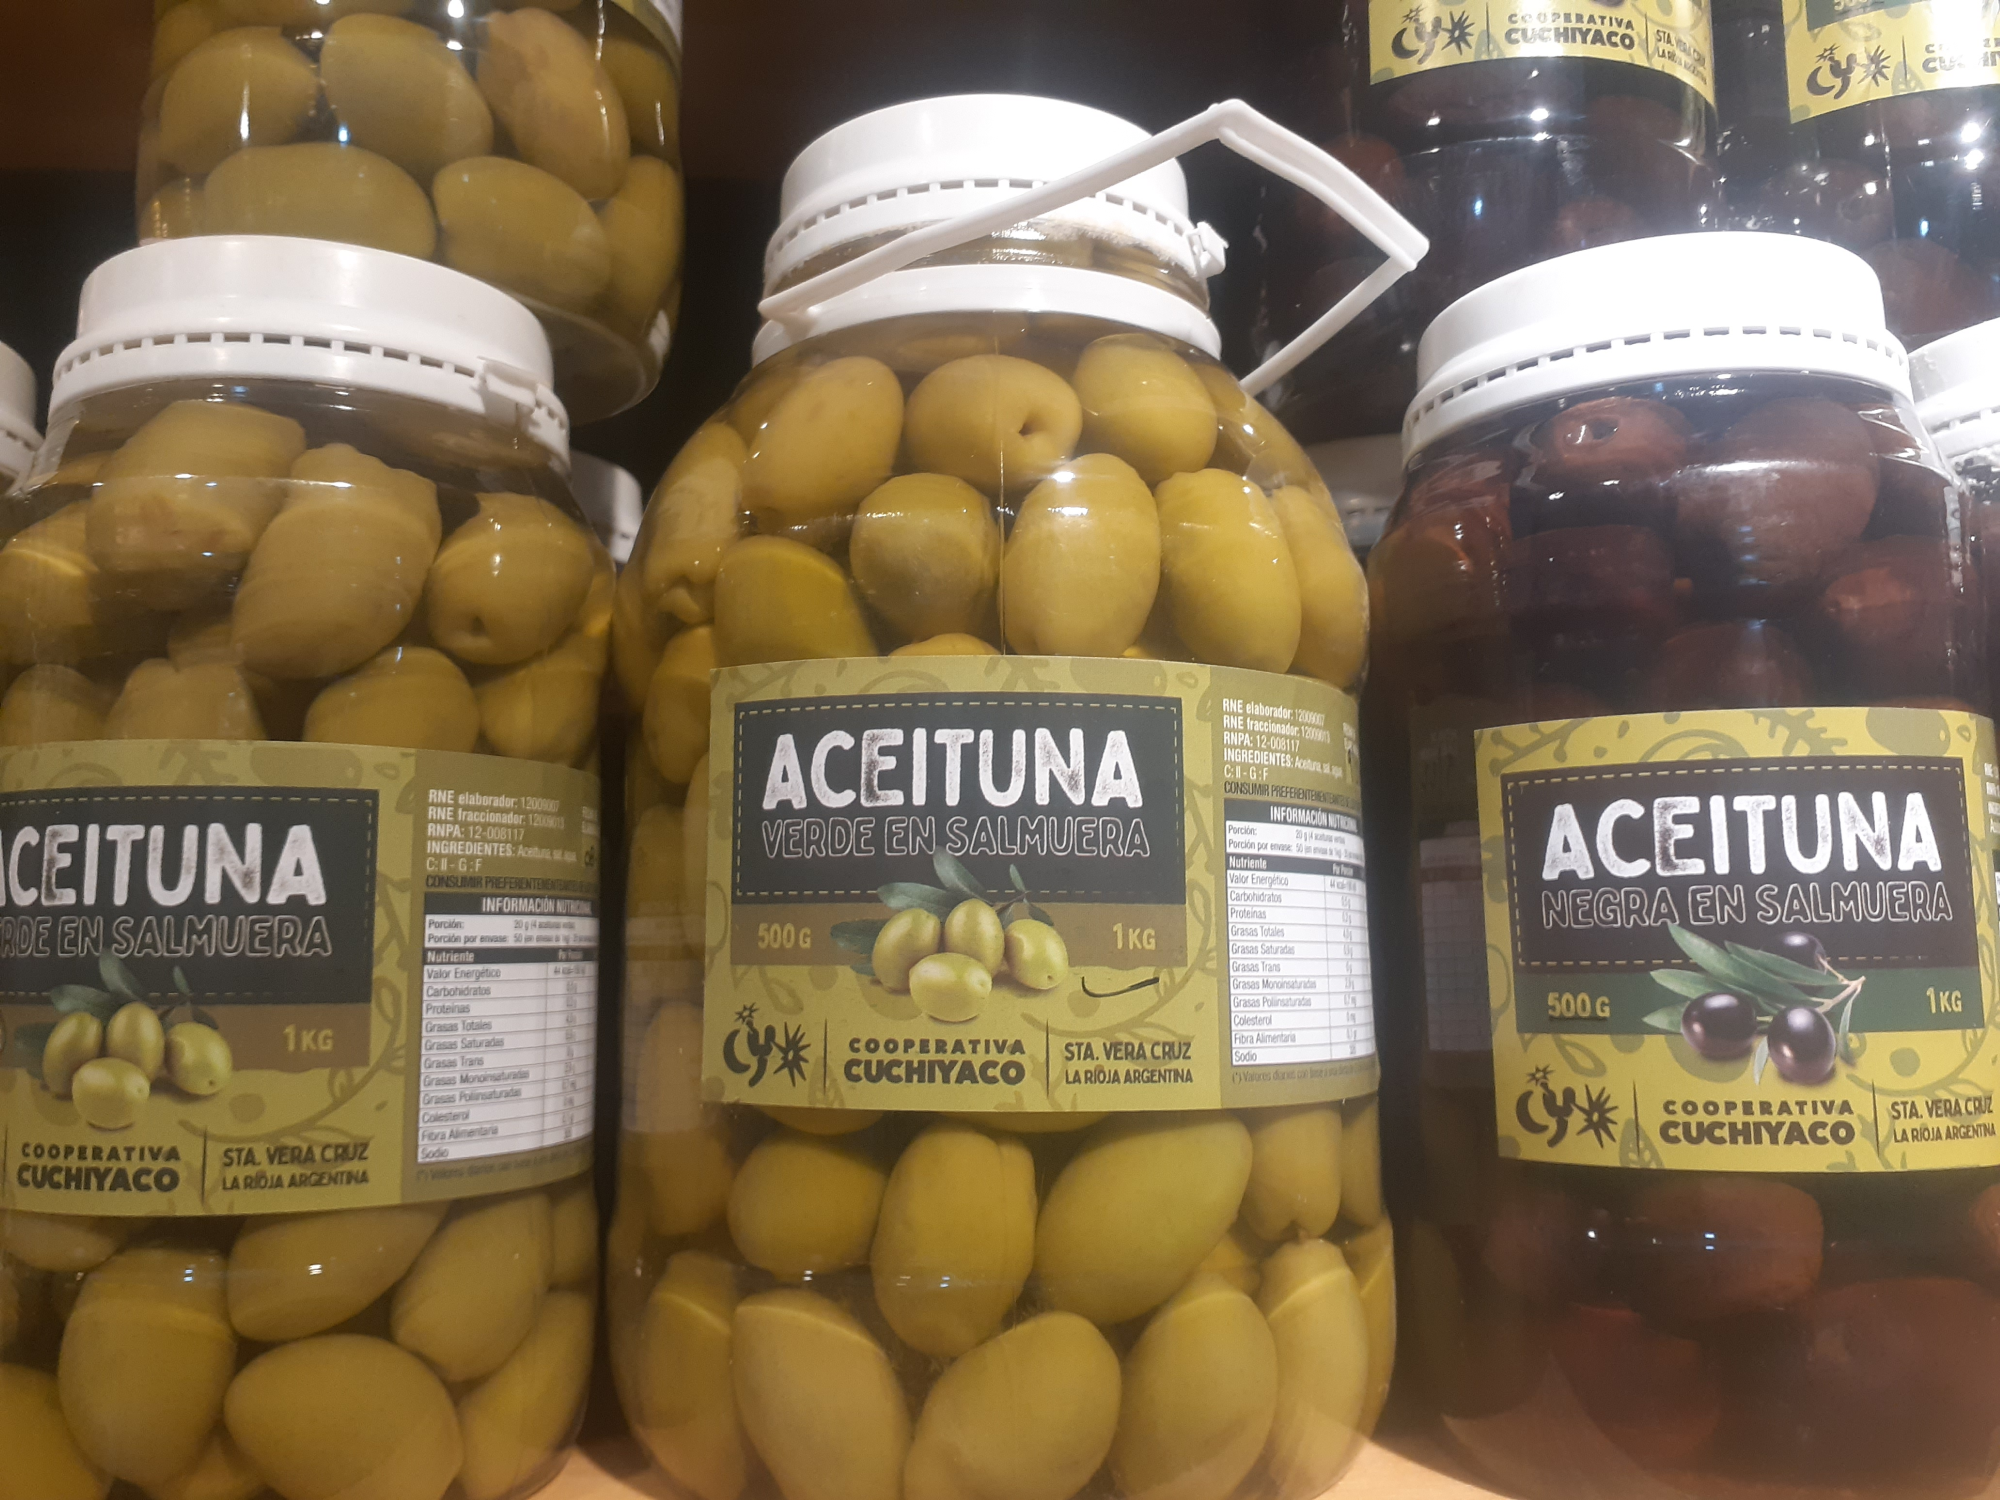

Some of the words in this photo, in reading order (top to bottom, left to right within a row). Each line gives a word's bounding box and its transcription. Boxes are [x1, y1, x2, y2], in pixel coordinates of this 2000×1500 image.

[1507, 12, 1635, 31] COOPERATIVA
[1504, 26, 1636, 51] CUCHIYACO
[1223, 698, 1243, 713] RNE
[1246, 701, 1293, 720] elaborador:
[1223, 715, 1244, 729] RNE
[1247, 717, 1300, 737] fraccionador:
[1223, 731, 1253, 747] RNPA:
[1223, 748, 1293, 767] INGREDIENTES:
[762, 728, 1143, 810] ACEITUNA
[1224, 781, 1270, 797] CONSUMIR
[428, 789, 455, 804] RNE
[458, 792, 518, 809] elaborador:
[427, 807, 454, 821] RNE
[458, 808, 526, 825] fraccionador:
[1270, 805, 1328, 827] INFORMACIÓN
[427, 823, 465, 838] RNPA:
[468, 826, 525, 841] 12-008117
[762, 817, 875, 858] VERDE
[885, 816, 936, 855] EN
[946, 815, 1150, 857] SALMUERA
[1228, 825, 1257, 836] Porción:
[1541, 791, 1943, 881] ACEITUNA
[427, 841, 515, 856] INGREDIENTES:
[1228, 839, 1256, 850] Porción
[1257, 841, 1269, 852] por
[0, 822, 327, 907] CEITUNA
[1229, 858, 1267, 870] Nutriente
[426, 875, 483, 889] CONSUMIR
[1229, 873, 1249, 887] Valor
[1251, 874, 1289, 889] Energético
[482, 896, 555, 913] INFORMACIÓN
[1229, 890, 1282, 904] Carbohidratos
[1541, 886, 1678, 929] NEGRA
[1688, 884, 1746, 925] EN
[1756, 880, 1953, 923] SALMUERA
[1230, 907, 1267, 919] Proteínas
[428, 919, 464, 930] Porción:
[1230, 925, 1259, 937] Grasas
[1260, 925, 1285, 938] Totales
[58, 915, 104, 957] EN
[112, 914, 332, 957] SALMUERA
[428, 934, 461, 943] Porción
[464, 935, 477, 945] por
[427, 951, 474, 962] Nutriente
[1231, 943, 1259, 955] Grasas
[1260, 943, 1295, 955] Saturadas
[427, 968, 451, 979] Valor
[454, 968, 501, 981] Energético
[1232, 961, 1259, 973] Grasas
[1261, 961, 1281, 973] Trans
[426, 985, 491, 997] Carbohidratos
[1232, 979, 1260, 990] Grasas
[1233, 997, 1260, 1008] Grasas
[425, 1022, 458, 1033] Grasas
[461, 1020, 492, 1031] Totales
[1234, 1014, 1273, 1026] Colesterol
[424, 1040, 458, 1050] Grasas
[461, 1037, 504, 1049] Saturadas
[849, 1037, 1025, 1054] COOPERATIVA
[1234, 1032, 1254, 1044] Fibra
[1256, 1031, 1296, 1044] Alimentaria
[1064, 1042, 1099, 1061] STA.
[1102, 1041, 1147, 1060] VERA
[1150, 1041, 1192, 1060] CRUZ
[1235, 1051, 1257, 1062] Sodio
[424, 1058, 457, 1069] Grasas
[460, 1056, 484, 1066] Trans
[844, 1058, 1026, 1086] CUCHIYACO
[1065, 1069, 1081, 1084] LA
[1124, 1068, 1193, 1083] ARGENTINA
[423, 1075, 456, 1087] Grasas
[422, 1093, 456, 1105] Grasas
[1662, 1099, 1854, 1117] COOPERATIVA
[1890, 1100, 1924, 1120] STA.
[1925, 1098, 1963, 1118] VERA
[1964, 1095, 1994, 1115] CRUZ
[422, 1110, 470, 1123] Colesterol
[421, 1130, 447, 1141] Fibra
[1659, 1120, 1856, 1146] CUCHIYACO
[1893, 1128, 1909, 1143] LA
[1945, 1123, 1996, 1140] ARGENTINA
[21, 1143, 181, 1162] COOPERATIVA
[223, 1147, 261, 1167] STA.
[267, 1144, 316, 1165] VERA
[321, 1142, 370, 1163] CRUZ
[17, 1167, 180, 1192] CUCHIYACO
[222, 1175, 240, 1190] LA
[287, 1170, 369, 1188] ARGENTINA
